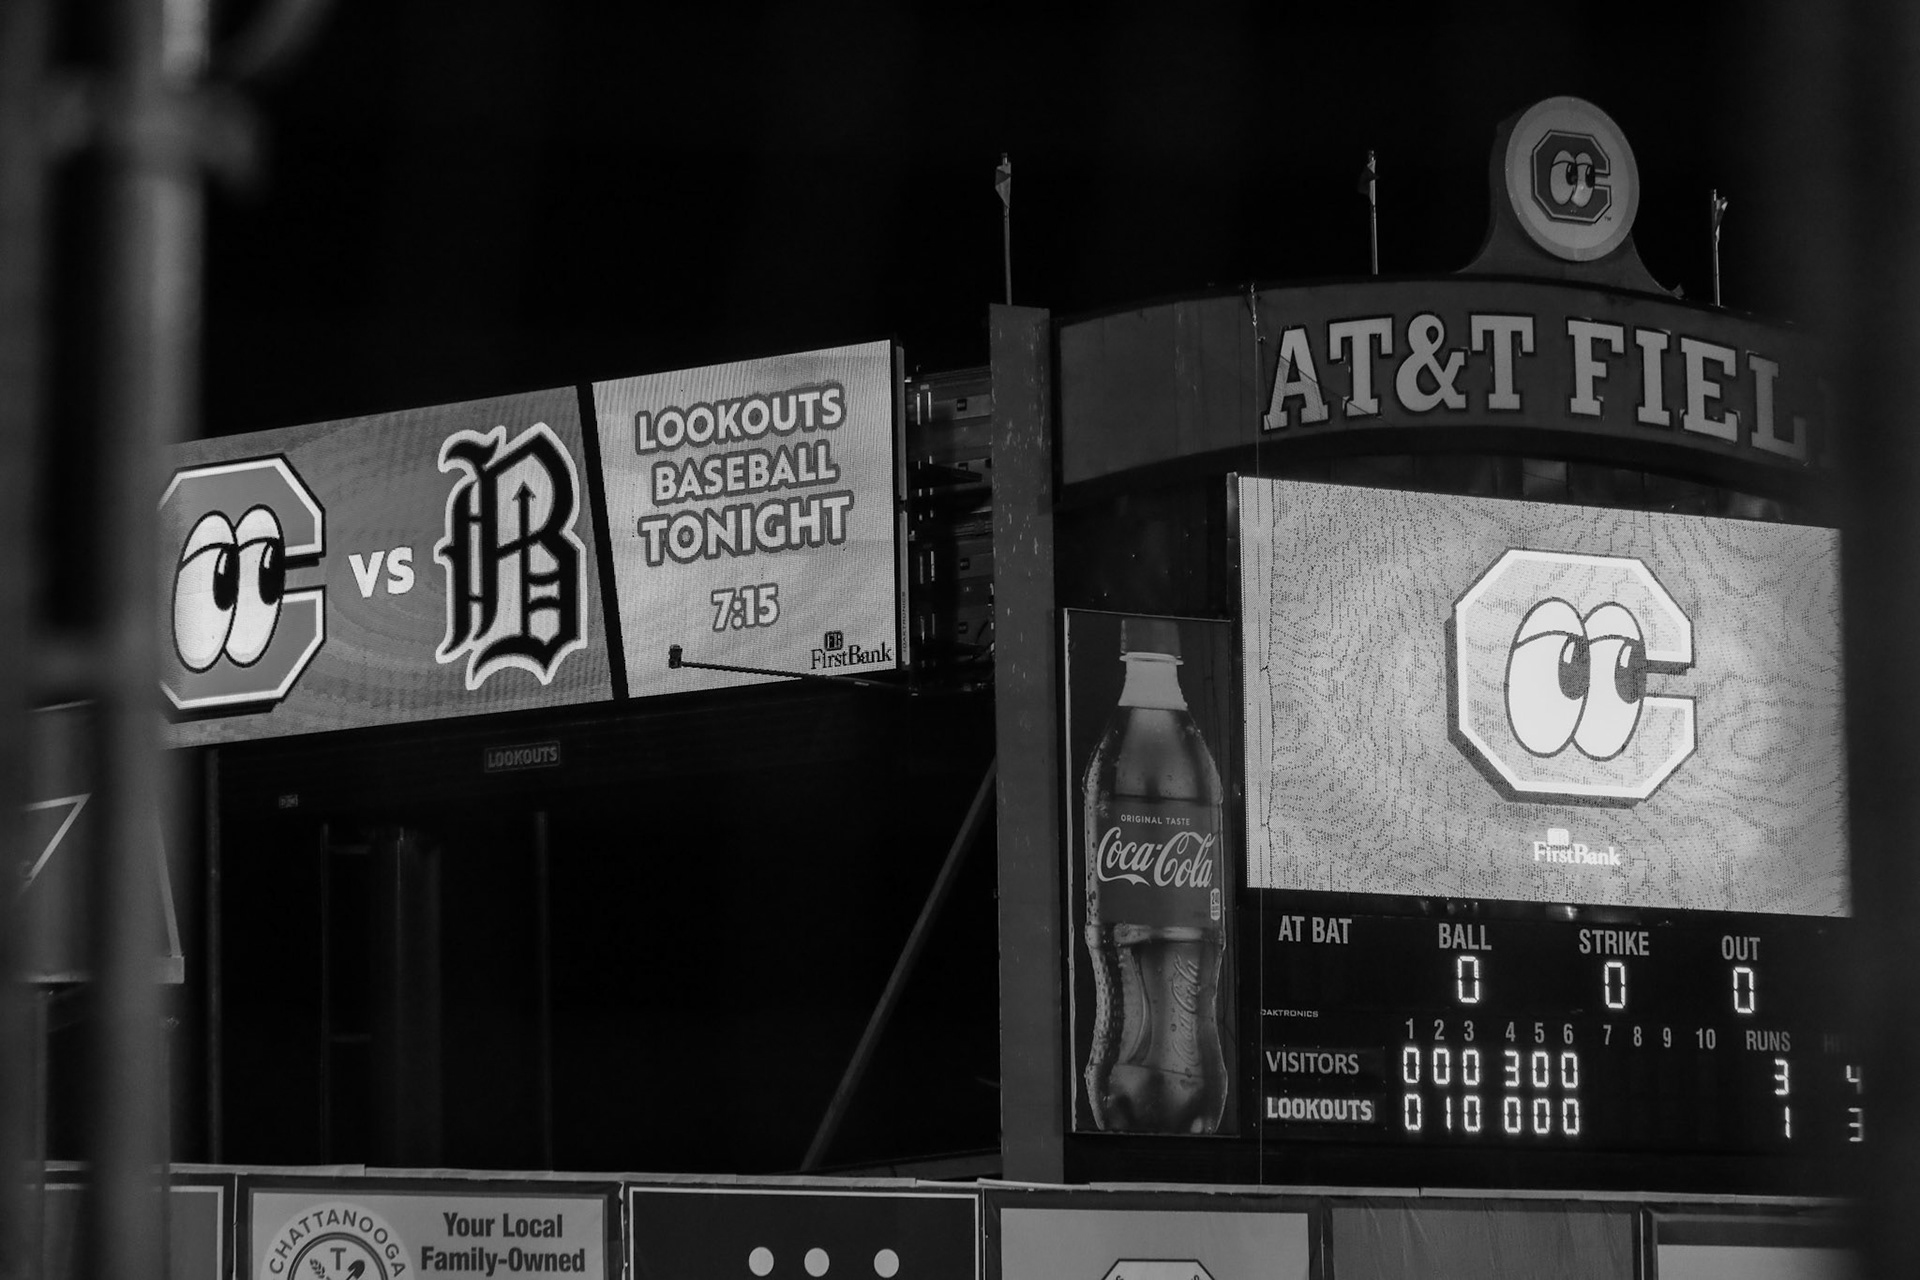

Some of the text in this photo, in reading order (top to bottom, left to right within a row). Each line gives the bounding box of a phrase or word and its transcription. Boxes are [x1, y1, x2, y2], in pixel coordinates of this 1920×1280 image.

[1261, 311, 1832, 467] AT&T FIEL
[637, 384, 844, 452] LOOKOUTS
[654, 442, 838, 504] BASEBALL
[639, 493, 851, 565] TONIGHT
[711, 582, 780, 632] 7:15
[810, 642, 893, 670] FirstBank
[487, 746, 558, 768] LOOKOUTS
[1120, 814, 1191, 826] ORIGINAL TASTE
[1097, 827, 1215, 888] Coca-Cola
[1533, 841, 1621, 866] FirstBank
[1278, 915, 1760, 961] AT BAT BALL STRIKE OUT
[1457, 955, 1755, 1014] 0 0 0
[1405, 1018, 1414, 1039] 1
[1433, 1019, 1445, 1040] 2
[1463, 1020, 1475, 1041] 3
[1505, 1021, 1516, 1042] 4
[1534, 1022, 1545, 1043] 5
[1563, 1023, 1574, 1044] 6
[1603, 1024, 1612, 1045] 7
[1633, 1026, 1642, 1047] 8
[1663, 1027, 1672, 1048] 9
[1695, 1028, 1716, 1049] 10
[1745, 1029, 1791, 1052] RUNS
[1266, 1051, 1360, 1075] VISITORS
[1403, 1046, 1420, 1084] 0
[1433, 1048, 1450, 1085] 0
[1462, 1049, 1480, 1086] 0
[1504, 1050, 1519, 1087] 3
[1532, 1050, 1549, 1088] 0
[1561, 1051, 1579, 1089] 0
[1774, 1058, 1790, 1096] 3
[1266, 1097, 1373, 1122] LOOKOUTS
[1404, 1093, 1422, 1131] 0
[1463, 1095, 1481, 1132] 0
[1504, 1096, 1521, 1134] 0
[1533, 1098, 1550, 1134] 0
[1562, 1098, 1580, 1135] 0
[268, 1208, 406, 1278] CHATTANOOGA
[443, 1212, 563, 1238] Your Local
[420, 1246, 586, 1276] Family-Owned
